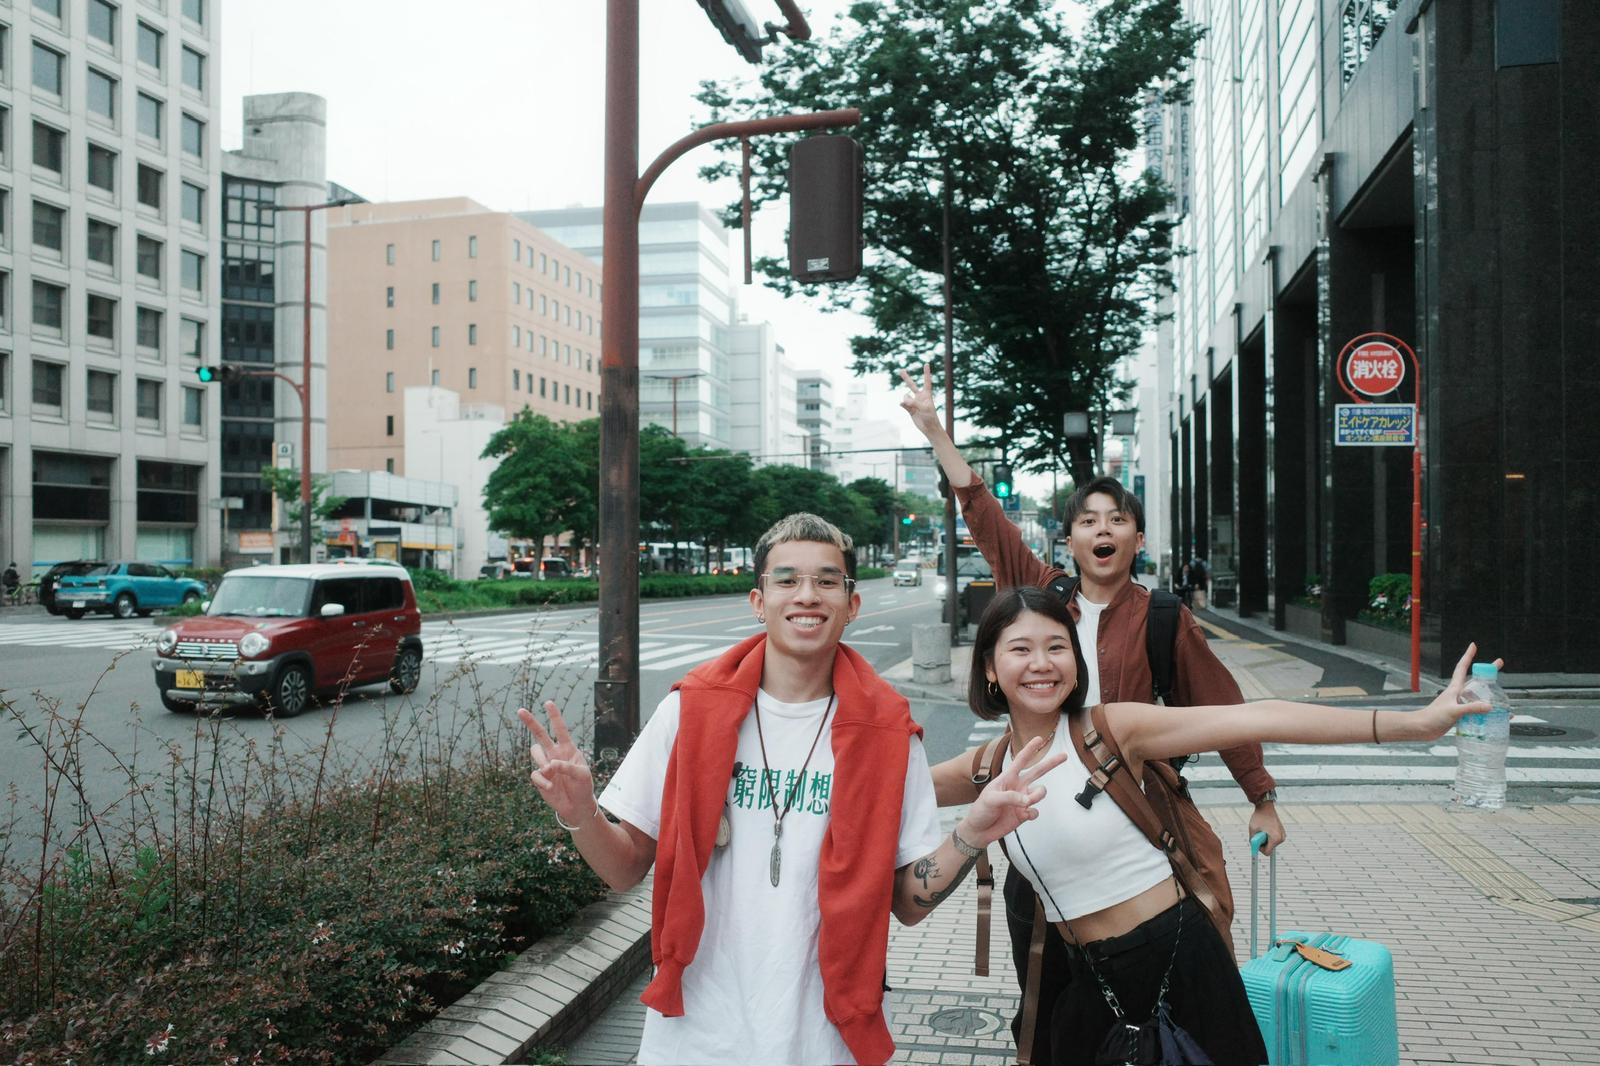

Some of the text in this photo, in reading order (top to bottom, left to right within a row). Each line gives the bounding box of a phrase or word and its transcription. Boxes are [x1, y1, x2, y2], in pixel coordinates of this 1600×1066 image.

[1353, 360, 1398, 379] 消火栓
[733, 765, 832, 816] 窮限制想
